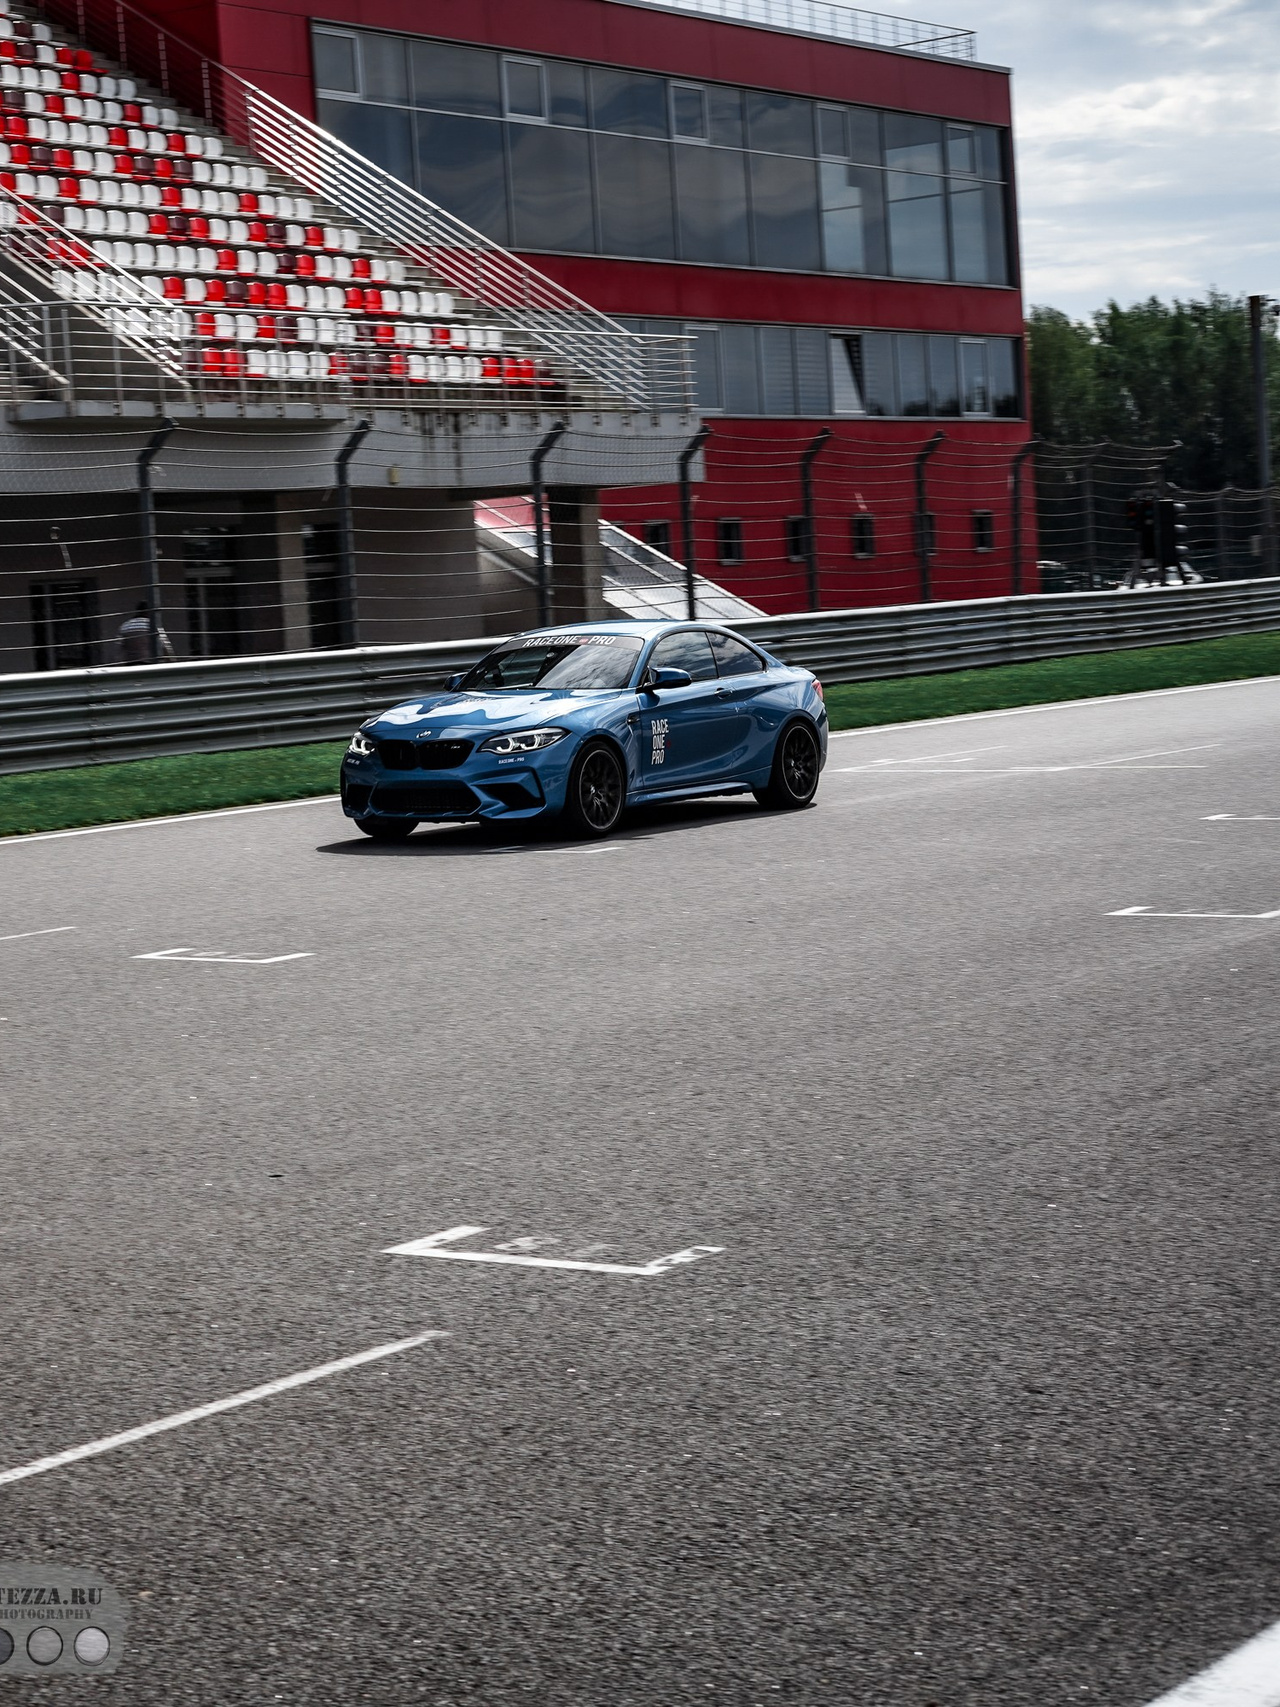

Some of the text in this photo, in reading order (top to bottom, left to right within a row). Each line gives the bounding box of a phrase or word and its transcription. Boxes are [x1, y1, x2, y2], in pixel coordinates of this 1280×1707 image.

[587, 635, 617, 645] PRO
[651, 718, 669, 735] RACE
[652, 734, 666, 750] ONE
[651, 749, 665, 765] PRO
